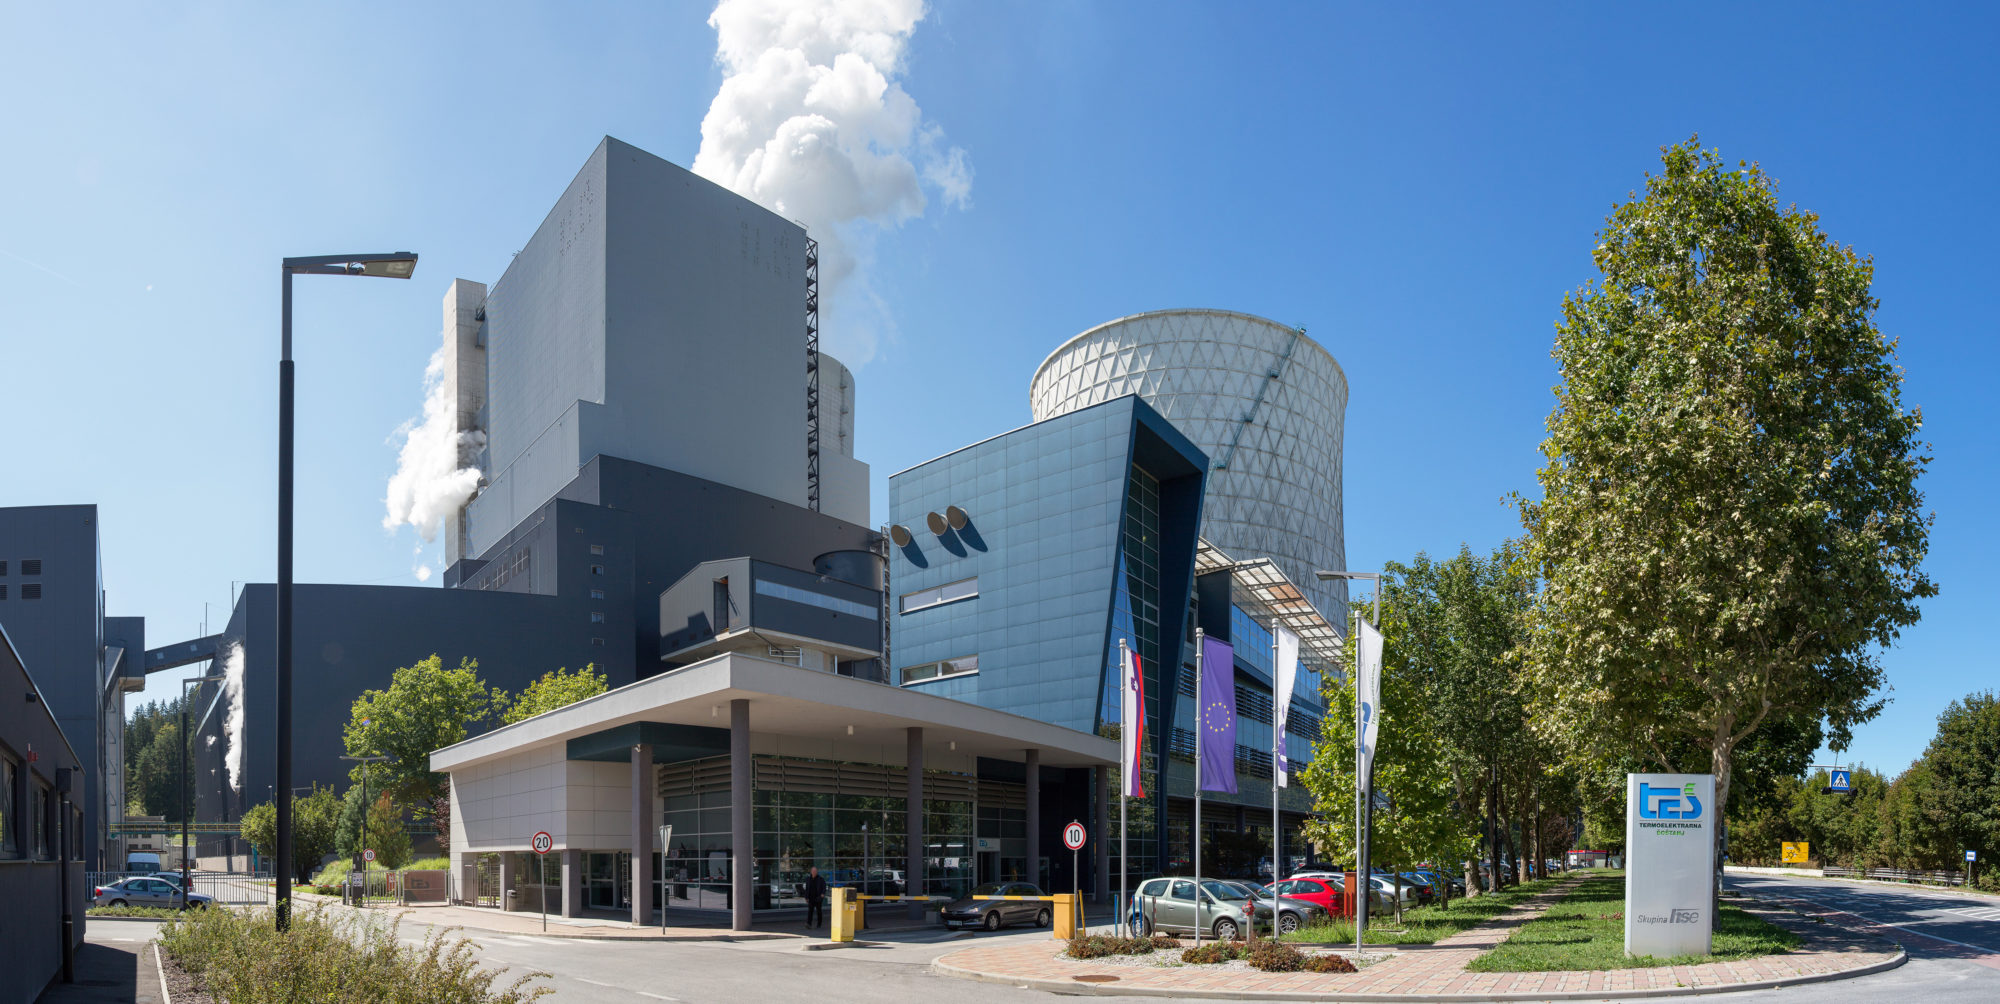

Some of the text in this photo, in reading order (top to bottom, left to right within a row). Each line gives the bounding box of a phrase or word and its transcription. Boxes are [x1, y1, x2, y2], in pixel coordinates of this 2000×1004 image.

[1069, 829, 1080, 843] 10
[535, 836, 549, 849] 20
[366, 851, 373, 859] 10
[1637, 914, 1668, 925] Skupina
